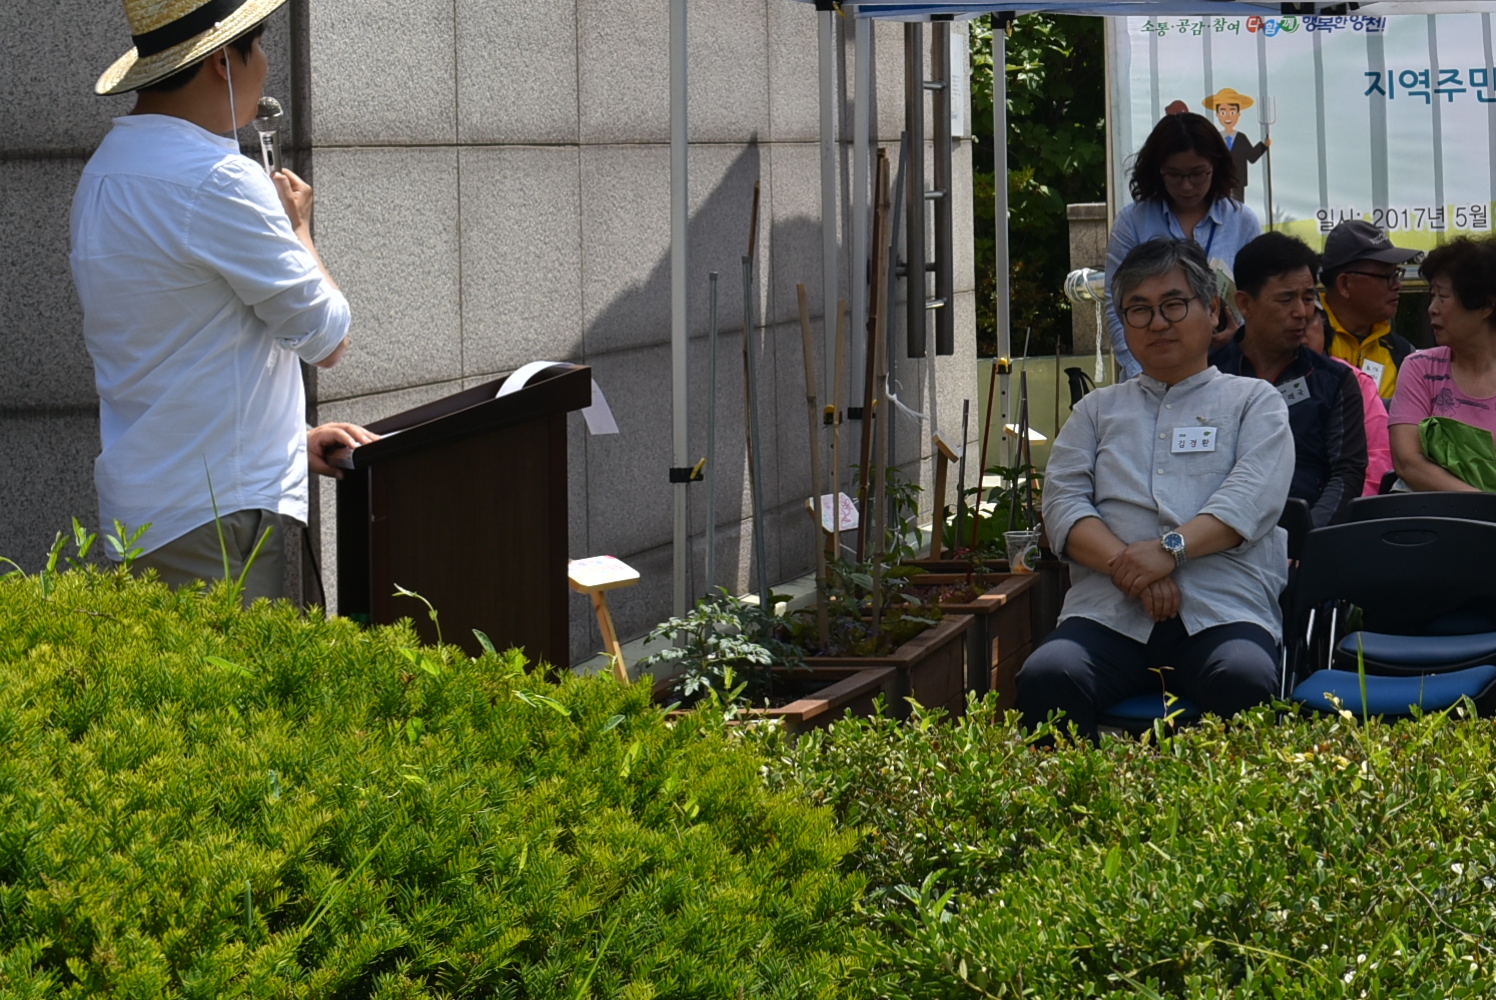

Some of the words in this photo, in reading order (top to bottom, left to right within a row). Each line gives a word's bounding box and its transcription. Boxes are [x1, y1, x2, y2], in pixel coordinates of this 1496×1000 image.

[1302, 15, 1349, 34] 행복한
[1372, 206, 1445, 229] 2017년
[1455, 204, 1488, 229] 5월
